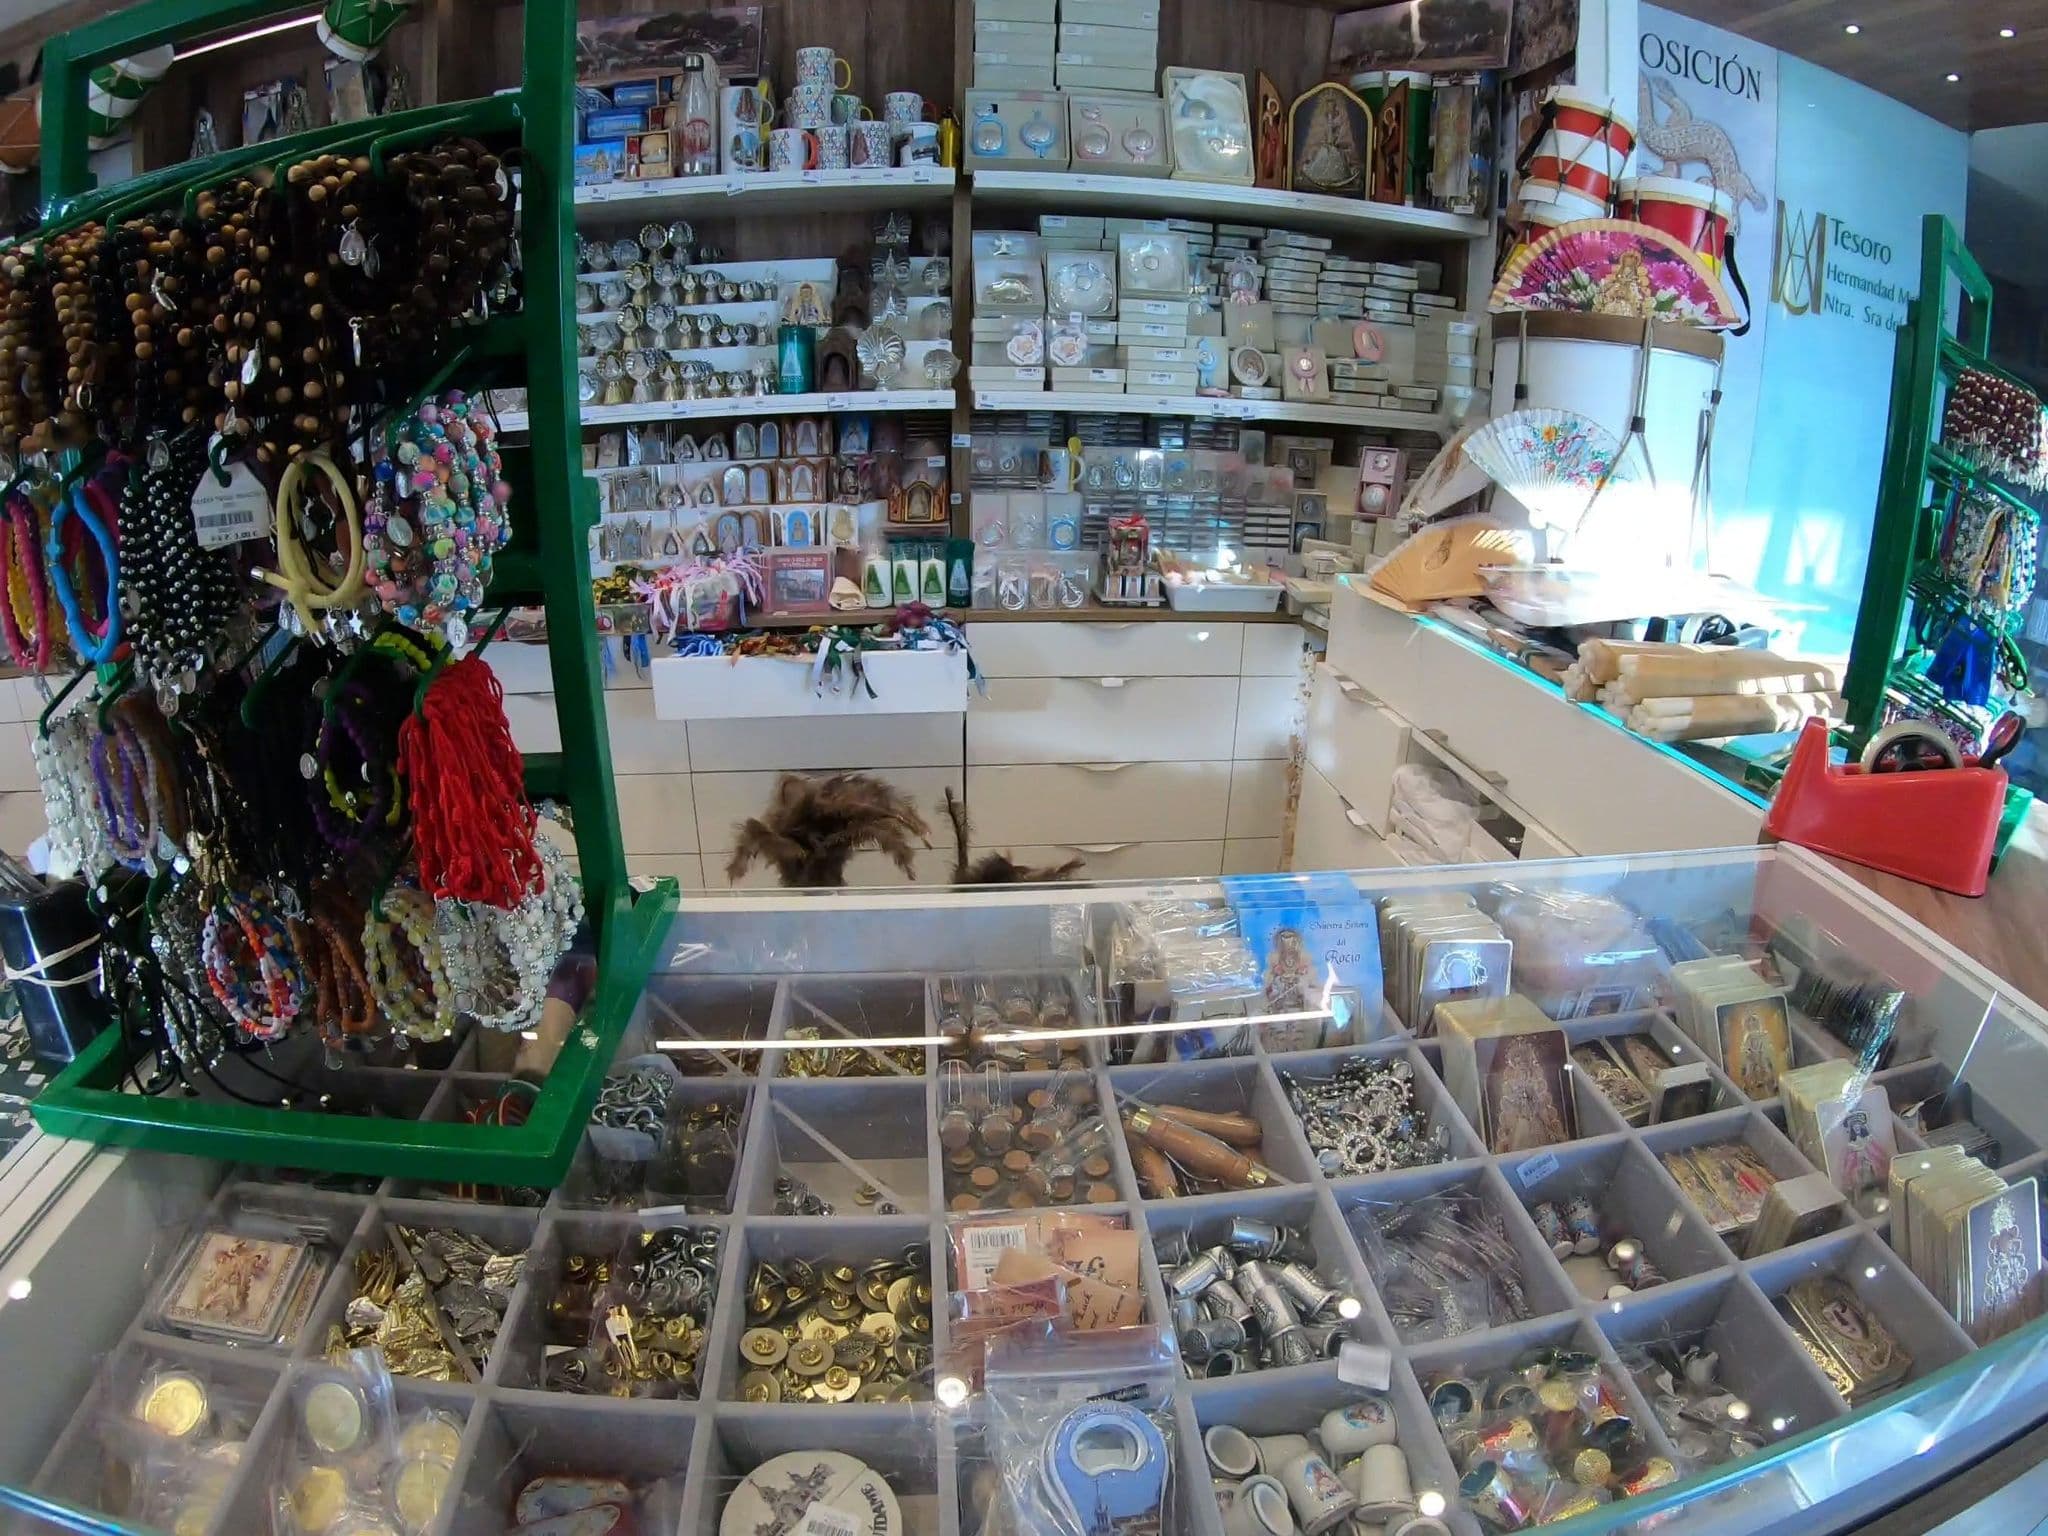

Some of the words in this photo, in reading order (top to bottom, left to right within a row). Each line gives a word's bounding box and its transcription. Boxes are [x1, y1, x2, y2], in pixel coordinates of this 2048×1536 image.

[1640, 32, 1761, 102] OSICIÓN
[1830, 217, 1892, 265] Tesoro
[1826, 261, 1895, 301] Hermandad
[1823, 293, 1854, 319] Ntra.
[1864, 305, 1882, 326] Sra
